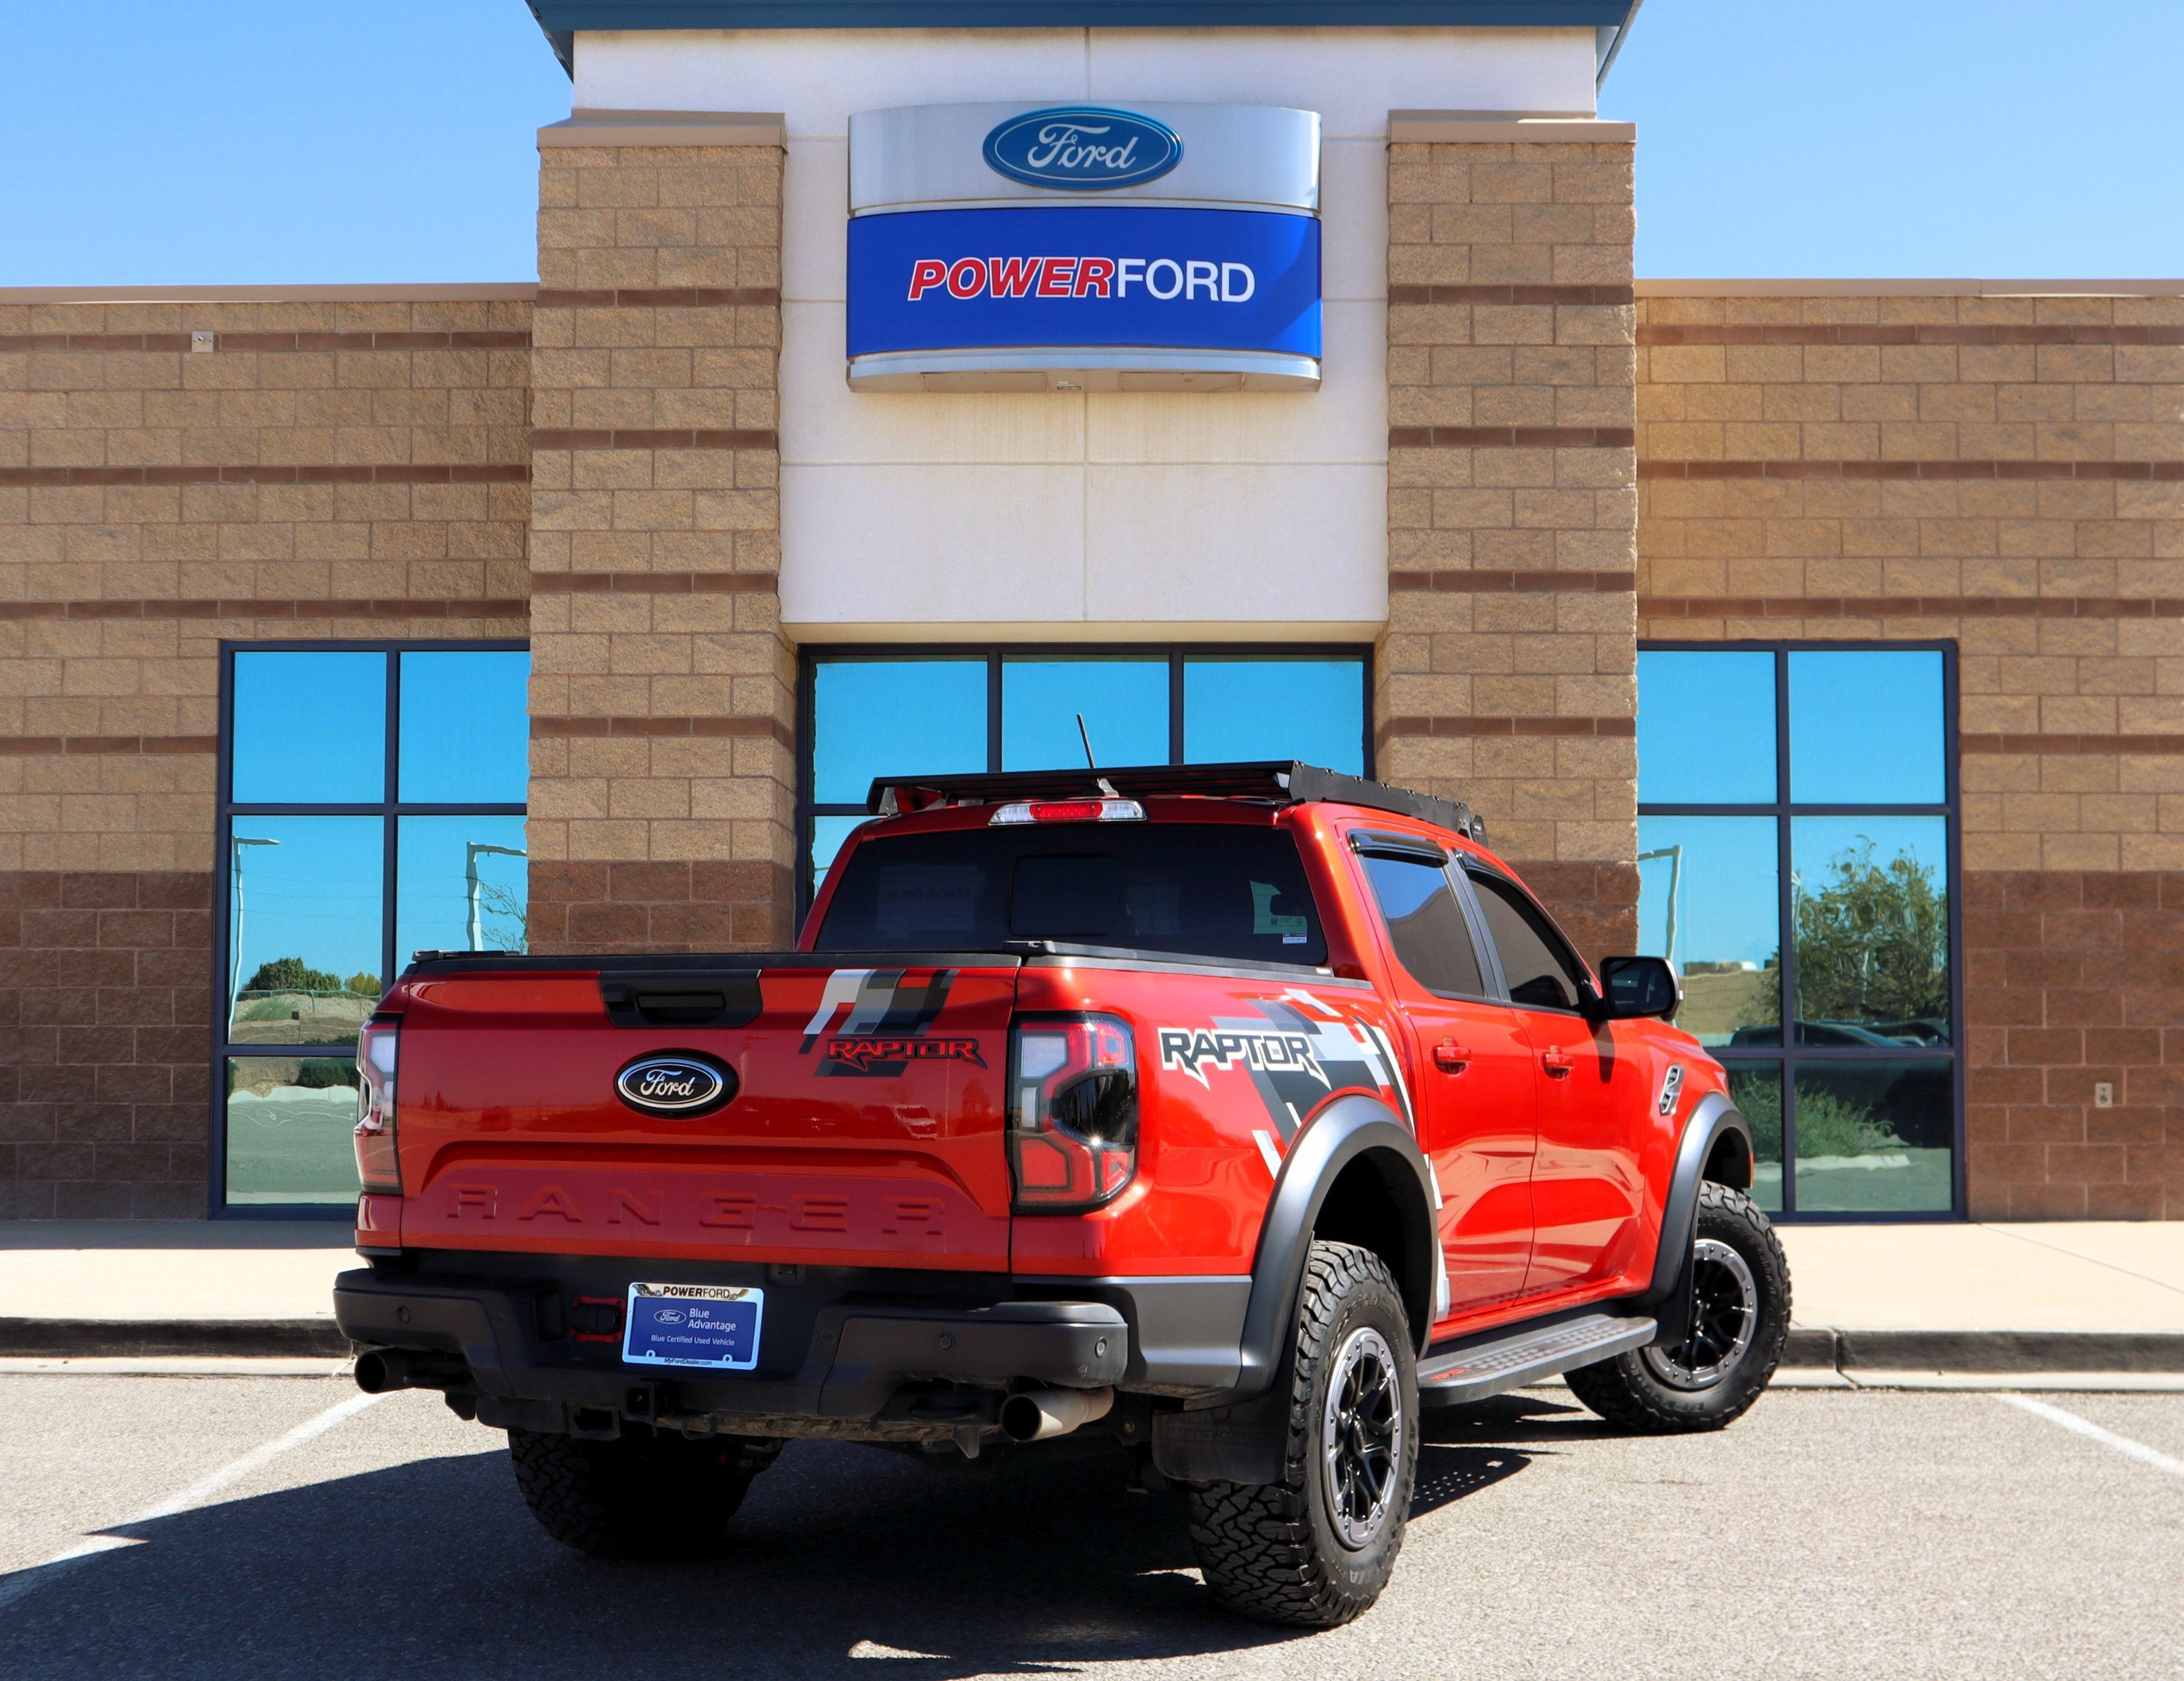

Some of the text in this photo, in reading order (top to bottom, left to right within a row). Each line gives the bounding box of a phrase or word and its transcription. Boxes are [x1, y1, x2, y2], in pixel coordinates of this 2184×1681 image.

[1027, 123, 1139, 169] Ford
[827, 1038, 988, 1071] RAPTOR
[1157, 1027, 1331, 1091] RAPTOR
[640, 1068, 696, 1097] Ford
[447, 1183, 944, 1236] RANGER
[659, 1311, 681, 1323] Ford
[687, 1319, 736, 1332] Advantage
[689, 1308, 710, 1319] Blue
[666, 1335, 693, 1344] Certified
[712, 1338, 735, 1346] Vehicle
